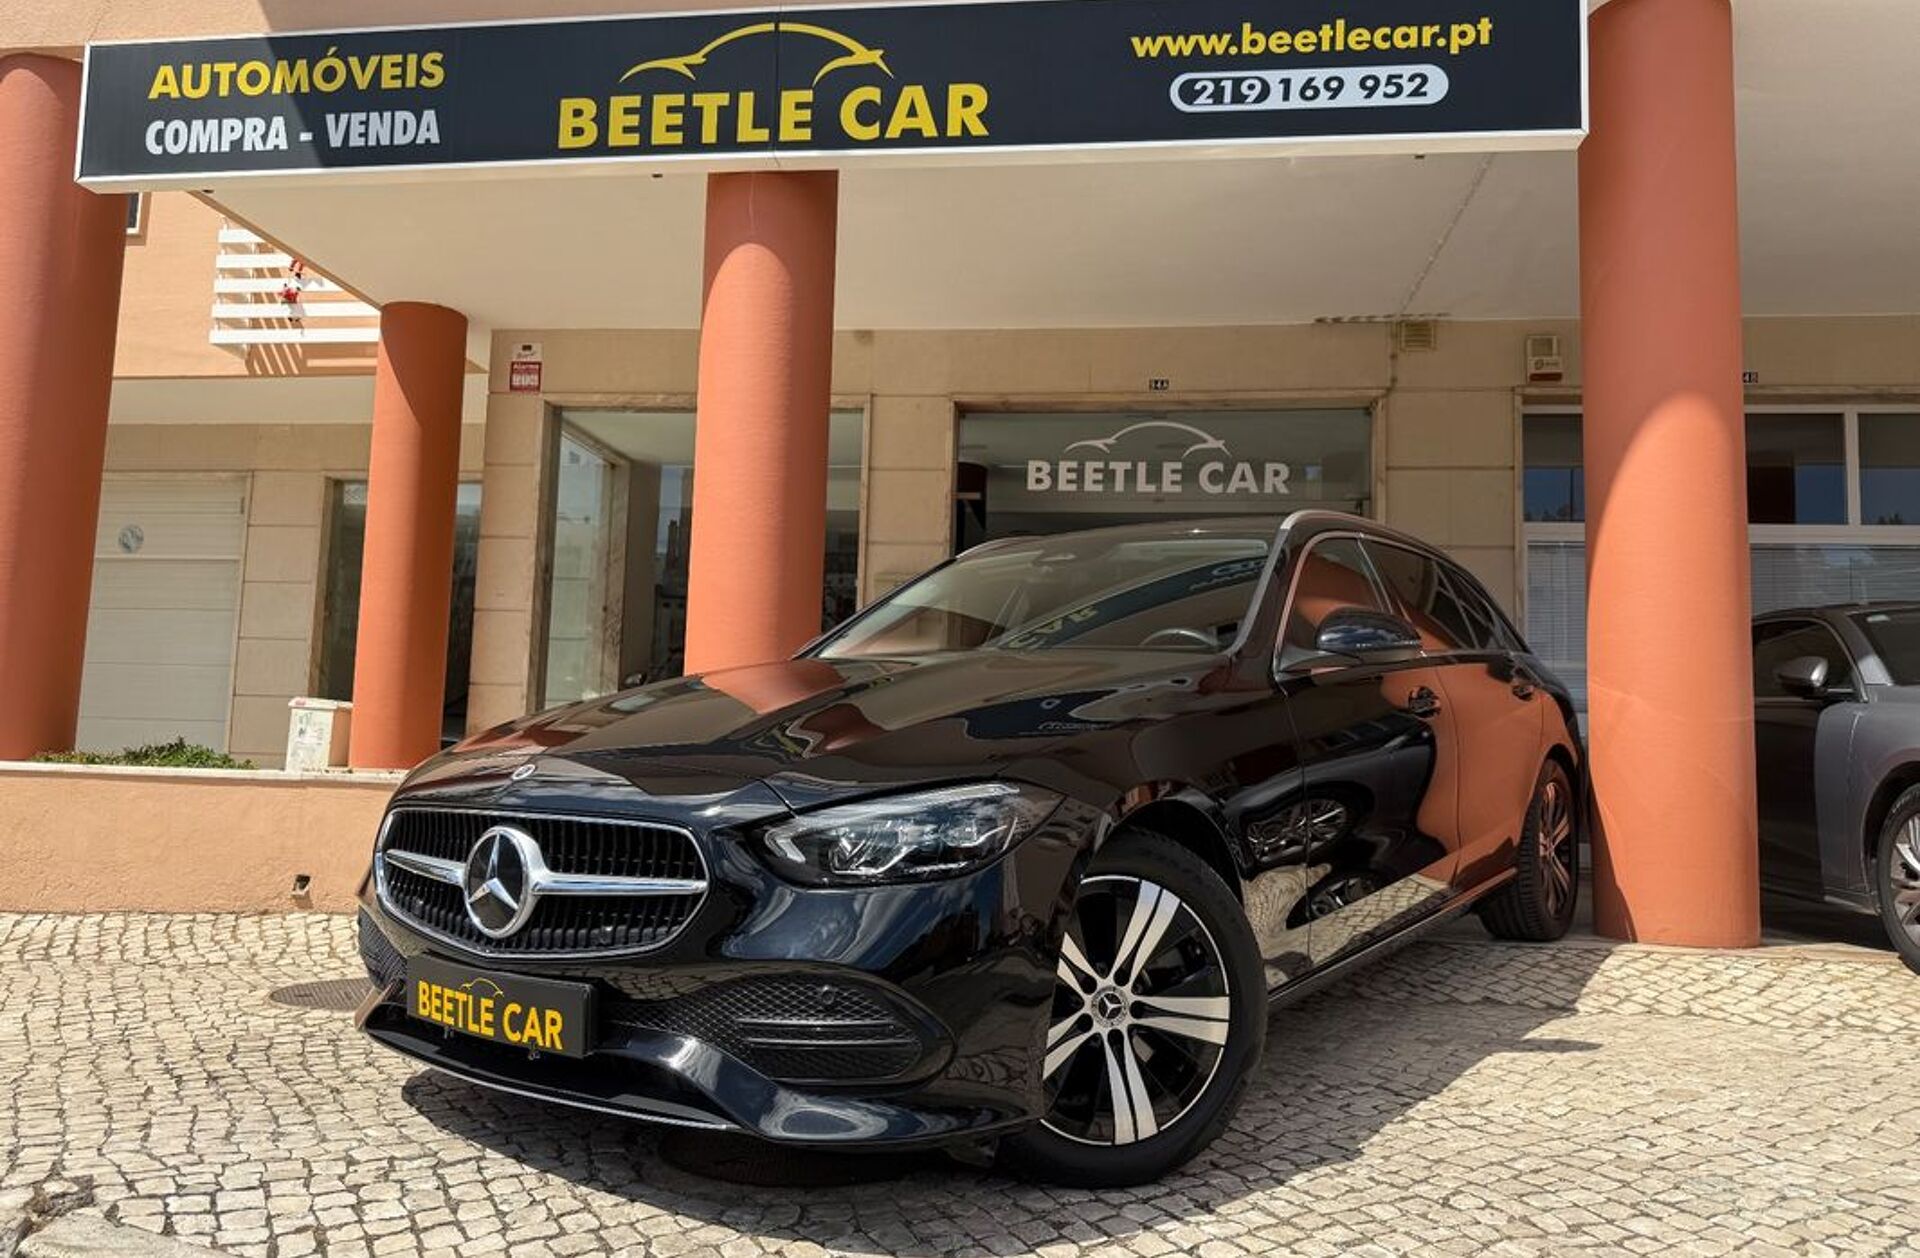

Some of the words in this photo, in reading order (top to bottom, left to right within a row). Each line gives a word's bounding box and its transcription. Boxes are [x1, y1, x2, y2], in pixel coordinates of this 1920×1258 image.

[1131, 17, 1493, 57] www.beetlecar.pt
[148, 46, 445, 99] AUTOMÓVEIS
[1193, 78, 1265, 106] 219
[1278, 75, 1345, 103] 169
[1359, 72, 1429, 99] 952
[145, 115, 288, 155] COMPRA
[325, 110, 440, 148] VENDA
[557, 88, 814, 150] BEETLE
[839, 82, 989, 142] CAR
[1026, 460, 1183, 493] BEETLE
[1198, 461, 1291, 496] CAR
[417, 980, 496, 1037] BEETLE
[502, 1002, 564, 1050] CAR
